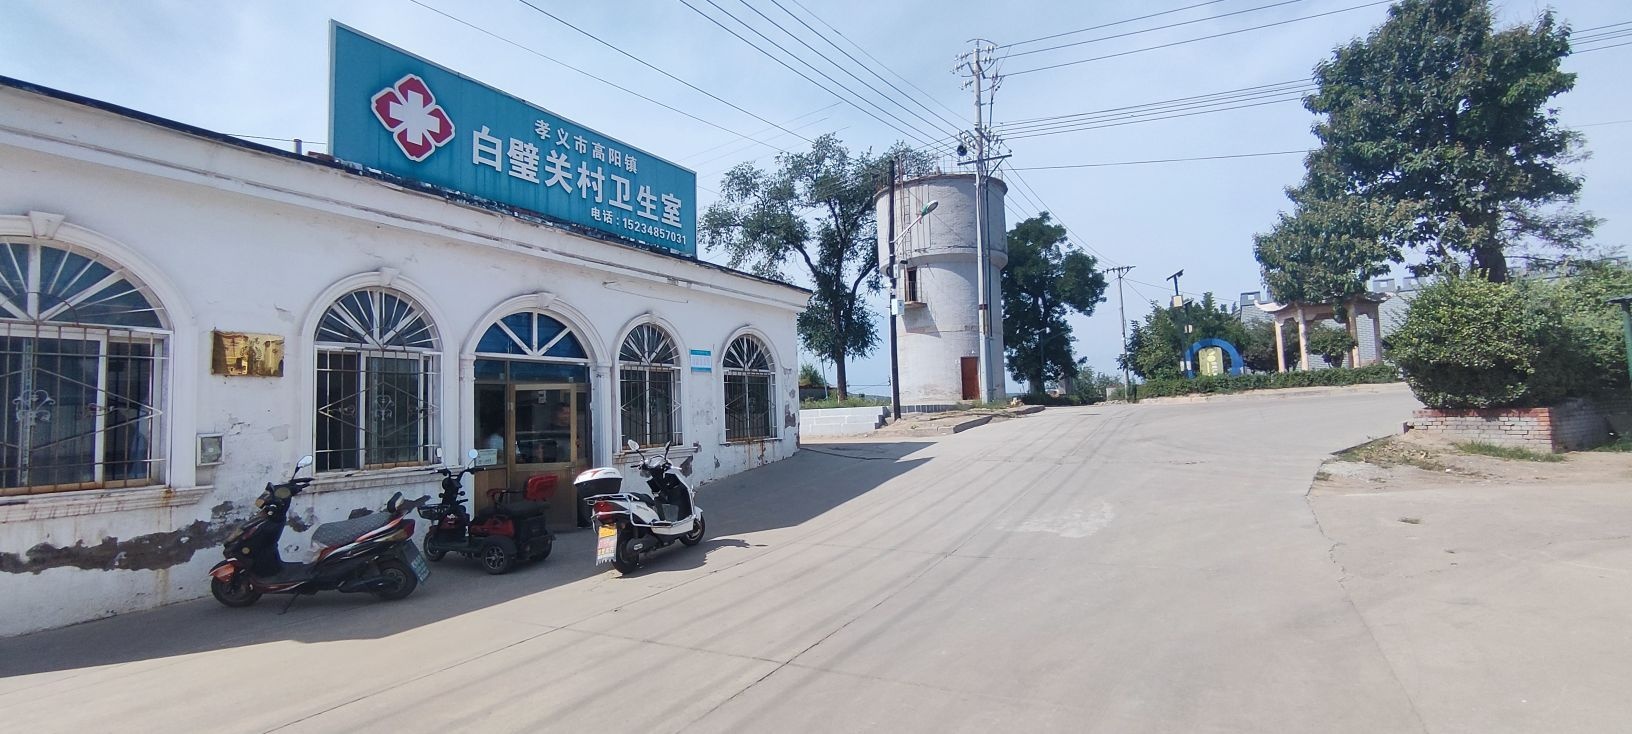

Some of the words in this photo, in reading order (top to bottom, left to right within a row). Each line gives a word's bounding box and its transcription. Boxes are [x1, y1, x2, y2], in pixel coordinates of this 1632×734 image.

[472, 125, 683, 228] 白璧关村卫生室
[534, 119, 638, 174] 孝义市高阳镇
